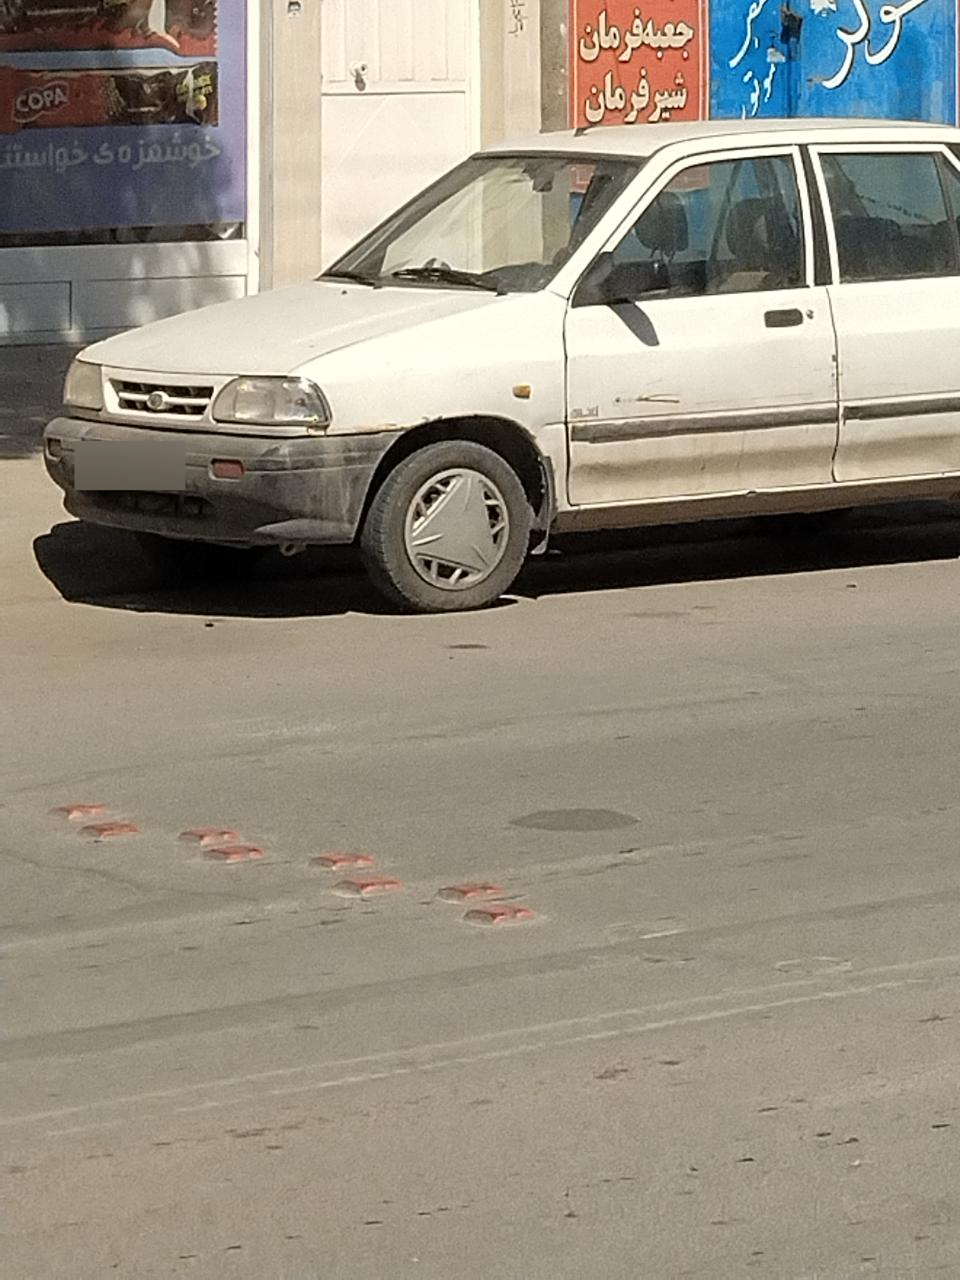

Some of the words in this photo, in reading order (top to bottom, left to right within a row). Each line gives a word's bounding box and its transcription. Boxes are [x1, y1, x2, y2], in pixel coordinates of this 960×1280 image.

[579, 7, 644, 62] فرمان
[642, 17, 694, 59] جعبه
[15, 88, 68, 112] COPA
[585, 68, 650, 123] فرمان
[648, 71, 688, 122] شیر
